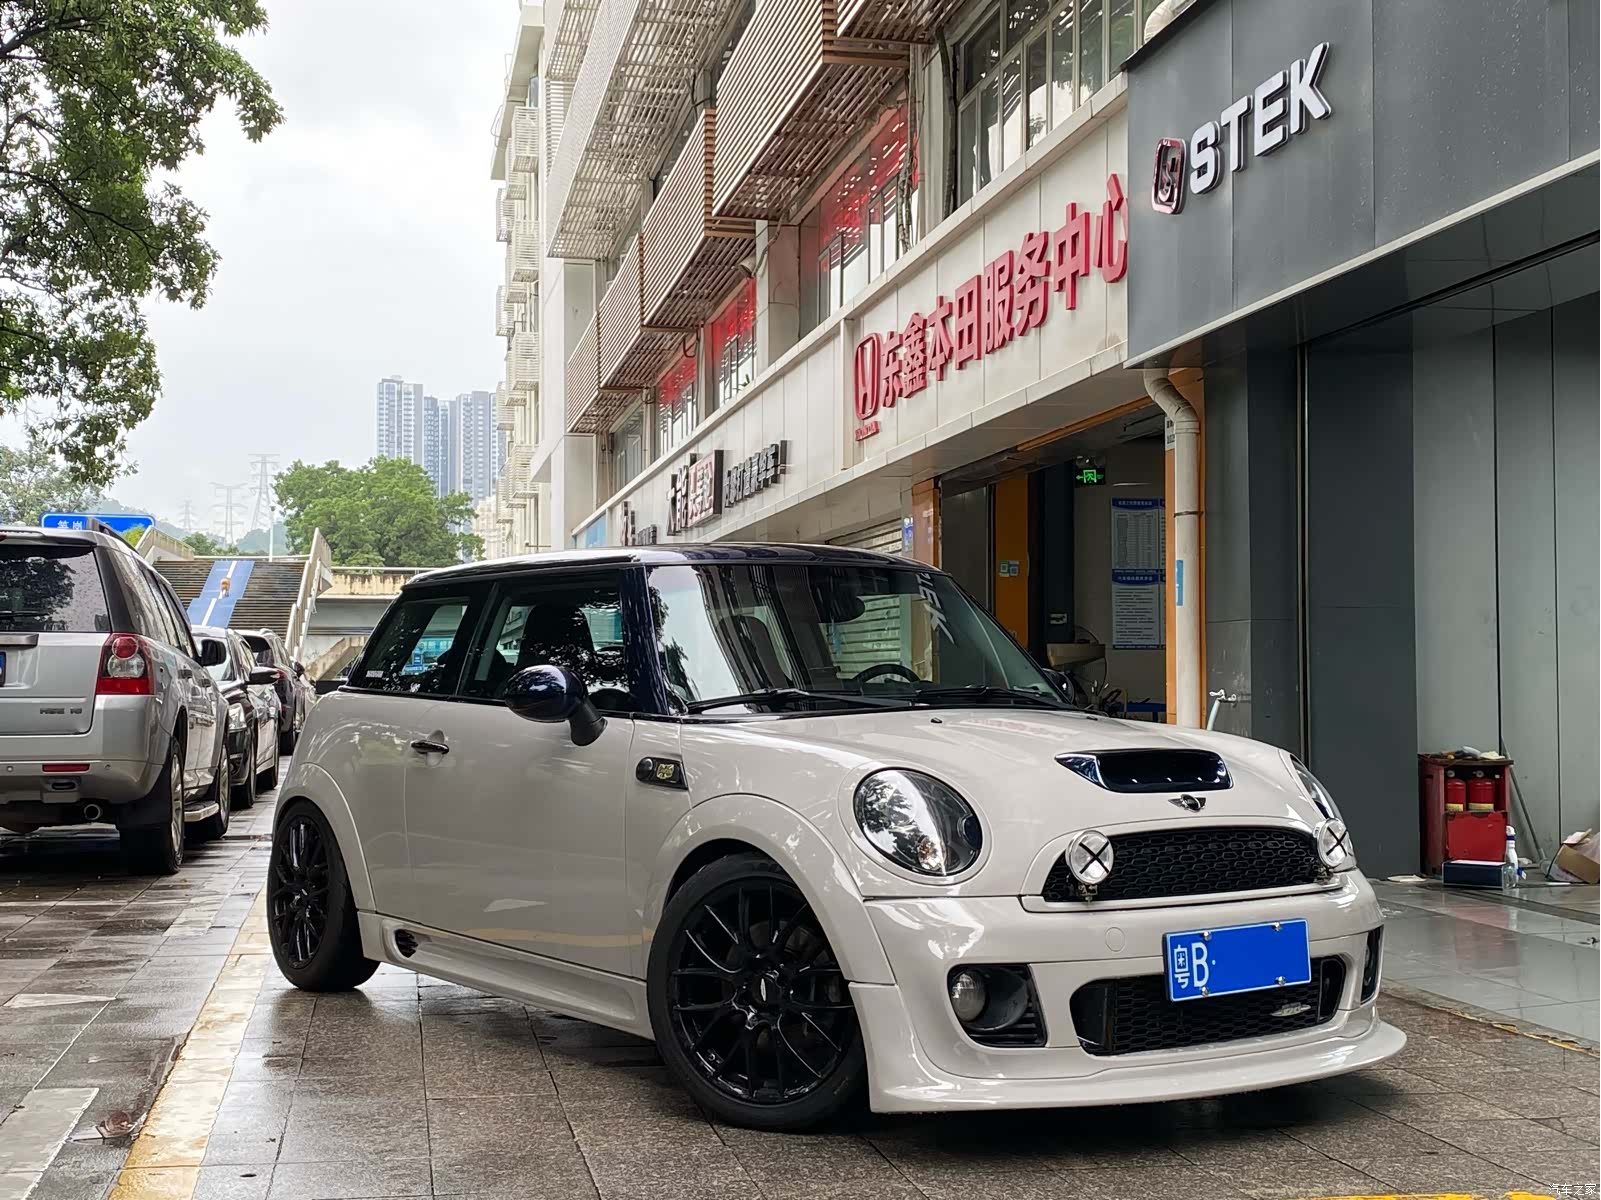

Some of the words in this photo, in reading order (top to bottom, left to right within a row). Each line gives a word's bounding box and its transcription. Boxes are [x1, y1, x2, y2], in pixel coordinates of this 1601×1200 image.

[1190, 42, 1331, 195] STEK
[881, 173, 1128, 408] 东鑫本田服务中心
